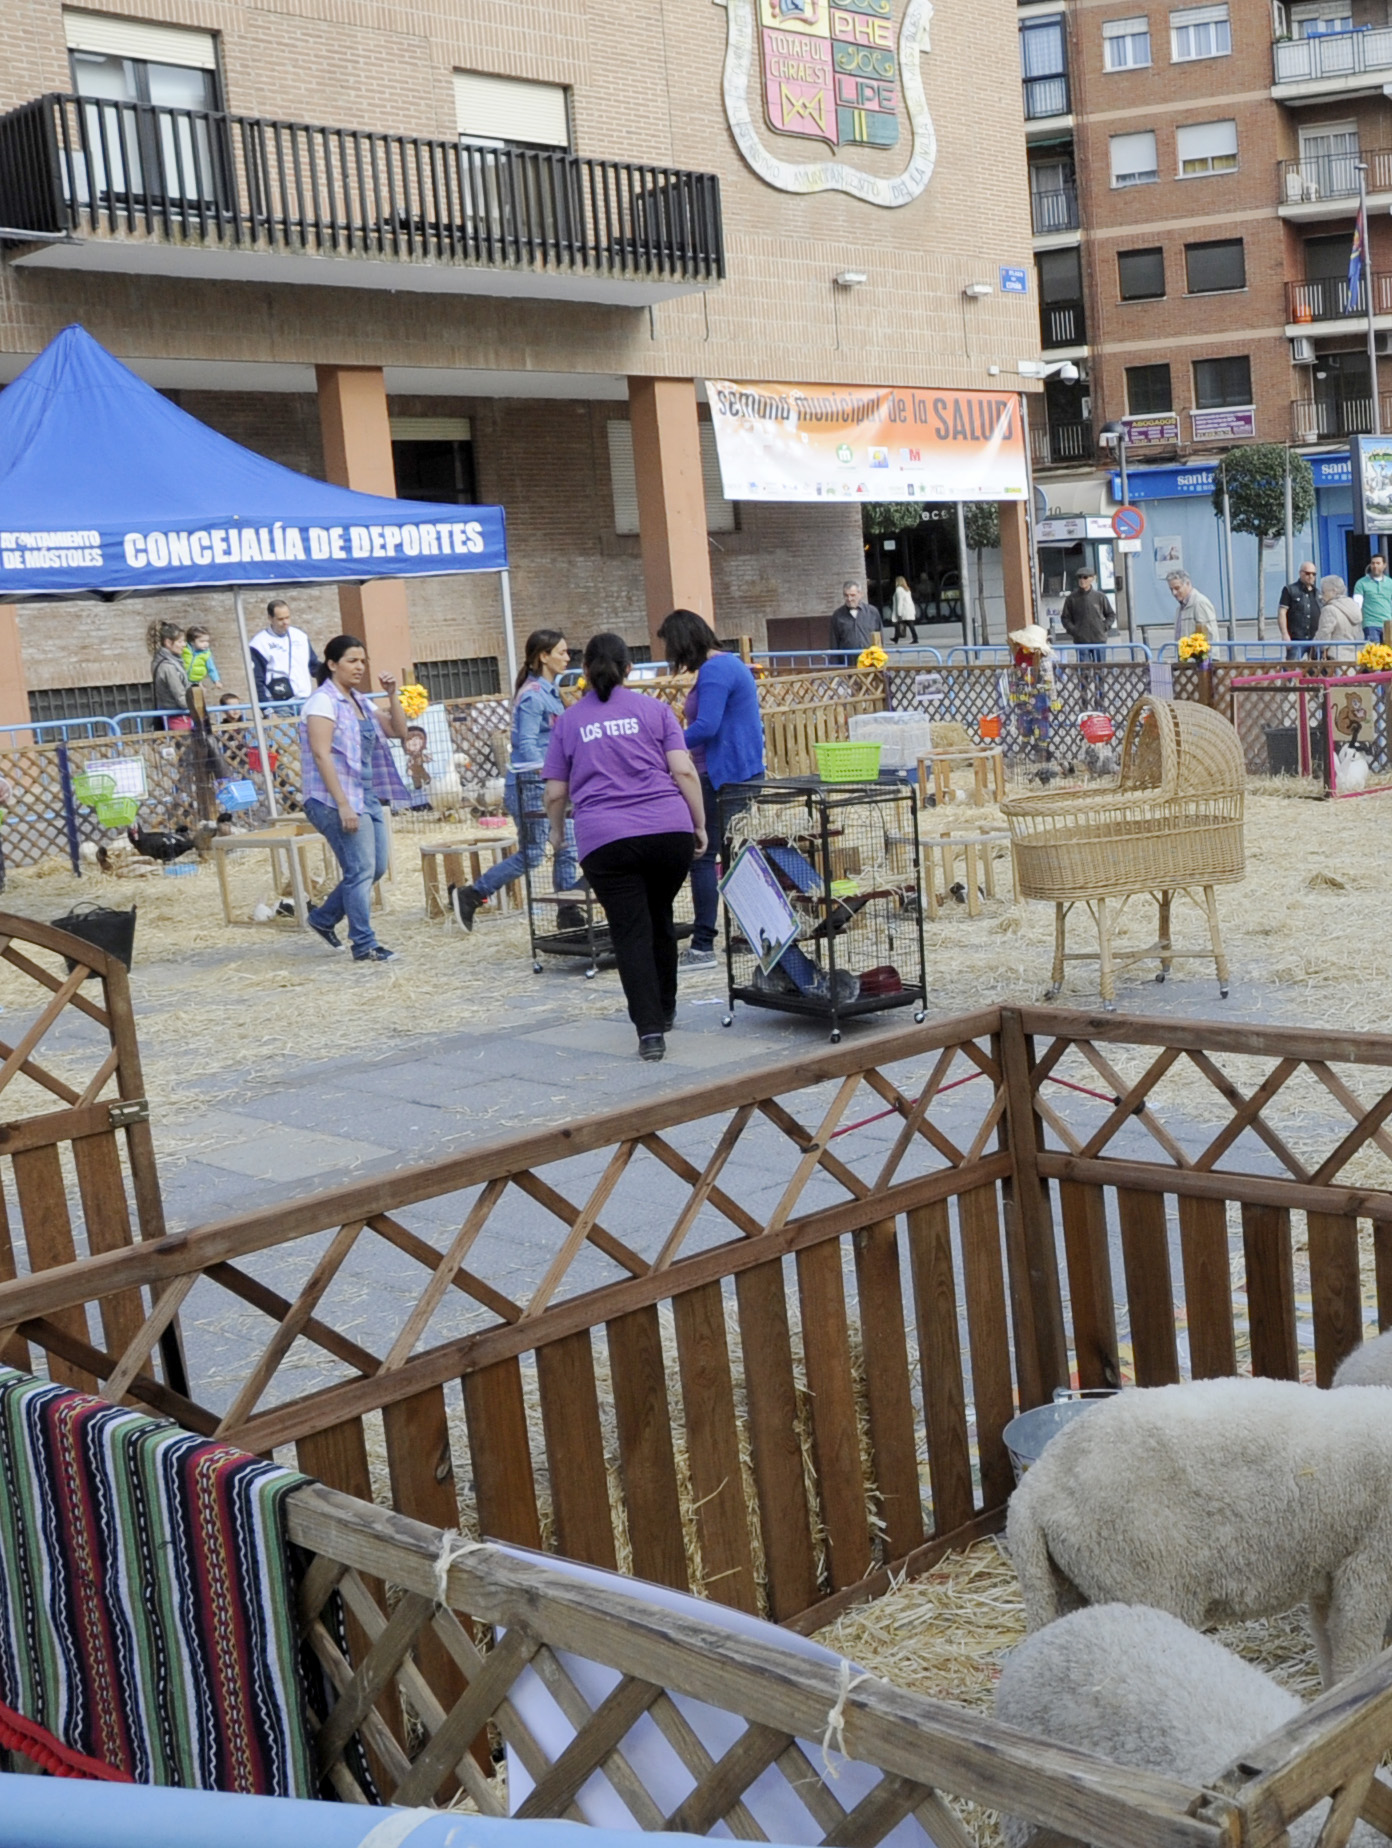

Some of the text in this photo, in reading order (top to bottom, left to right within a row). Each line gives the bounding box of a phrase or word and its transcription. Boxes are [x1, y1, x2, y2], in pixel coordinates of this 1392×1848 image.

[833, 11, 893, 47] PHE
[837, 76, 896, 110] LIPE
[717, 390, 1013, 441] semana municipal de la SALUD
[2, 546, 104, 569] DE MÓSTOLES
[123, 521, 485, 568] CONCEJALÍA DE DEPORTES
[580, 717, 639, 743] LOS TETES
